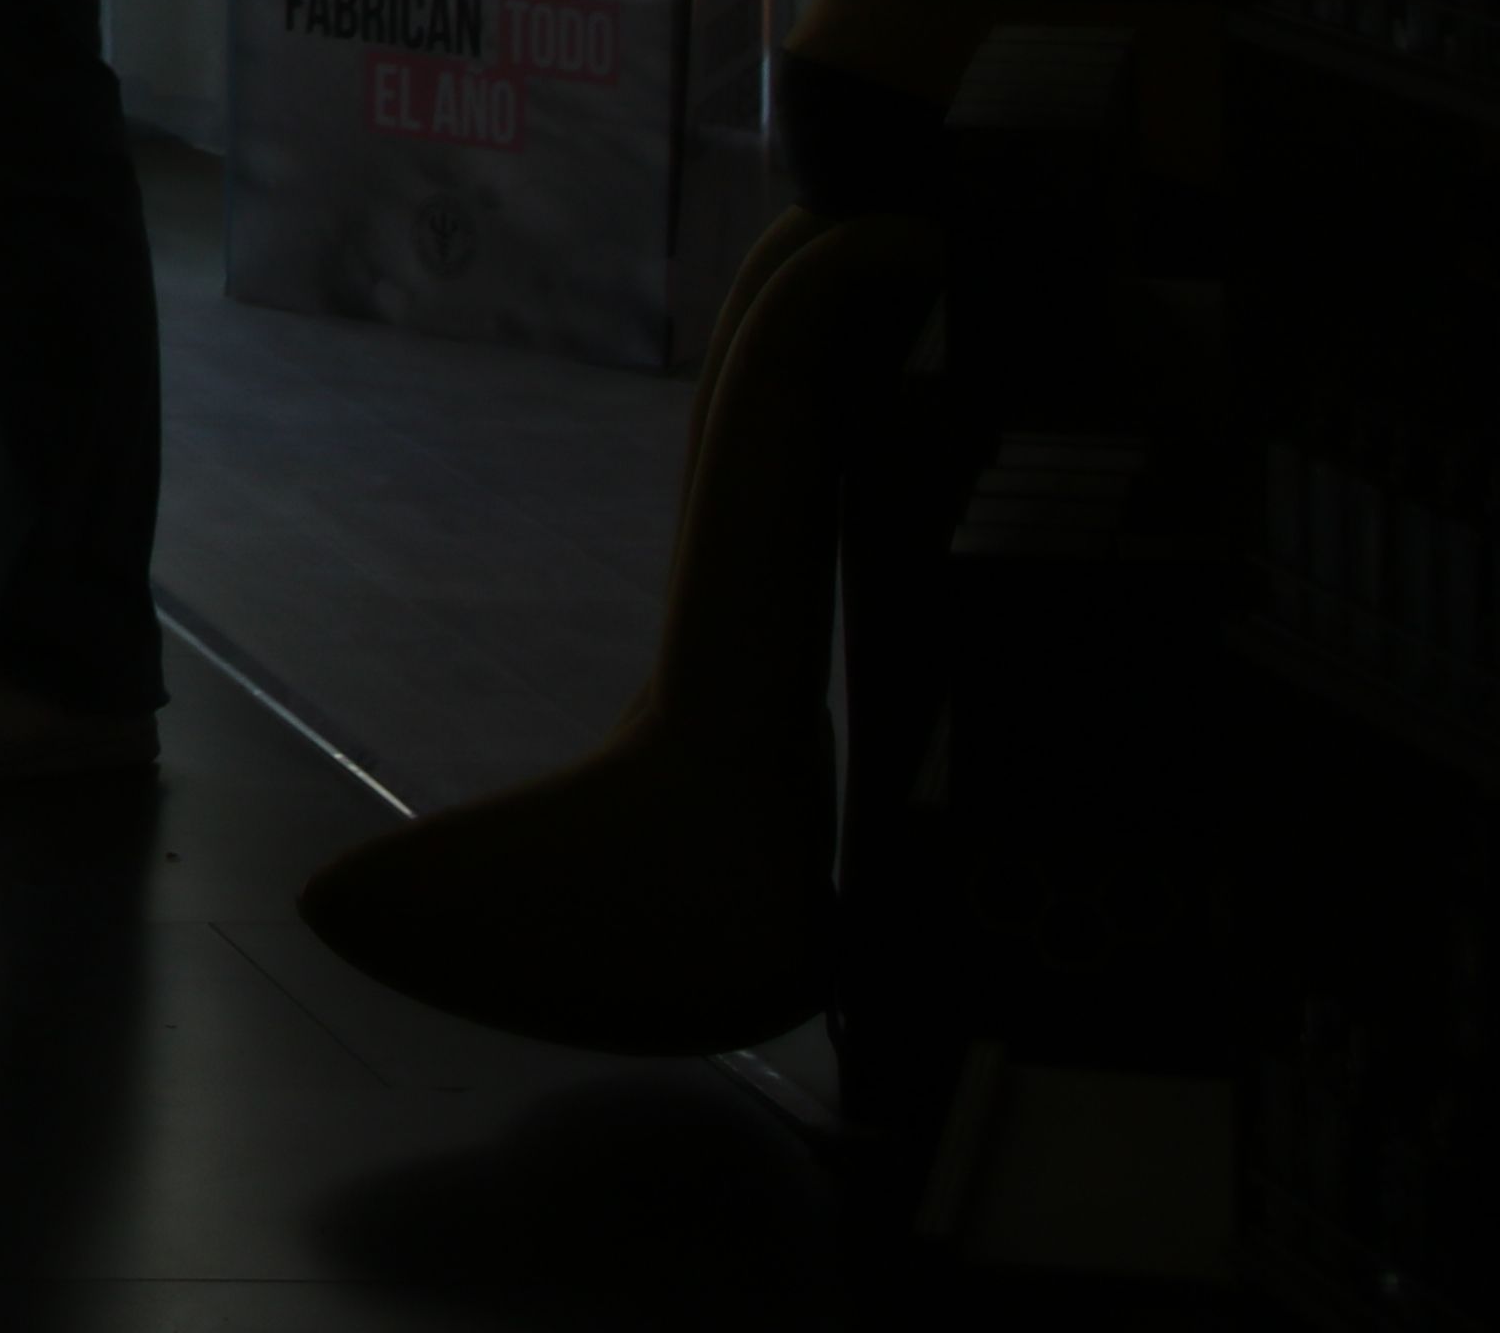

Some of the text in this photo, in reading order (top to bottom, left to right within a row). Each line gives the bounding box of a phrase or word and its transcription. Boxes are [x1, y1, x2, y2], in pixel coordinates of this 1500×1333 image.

[504, 0, 615, 77] TODO
[372, 63, 517, 144] EL AÑO
